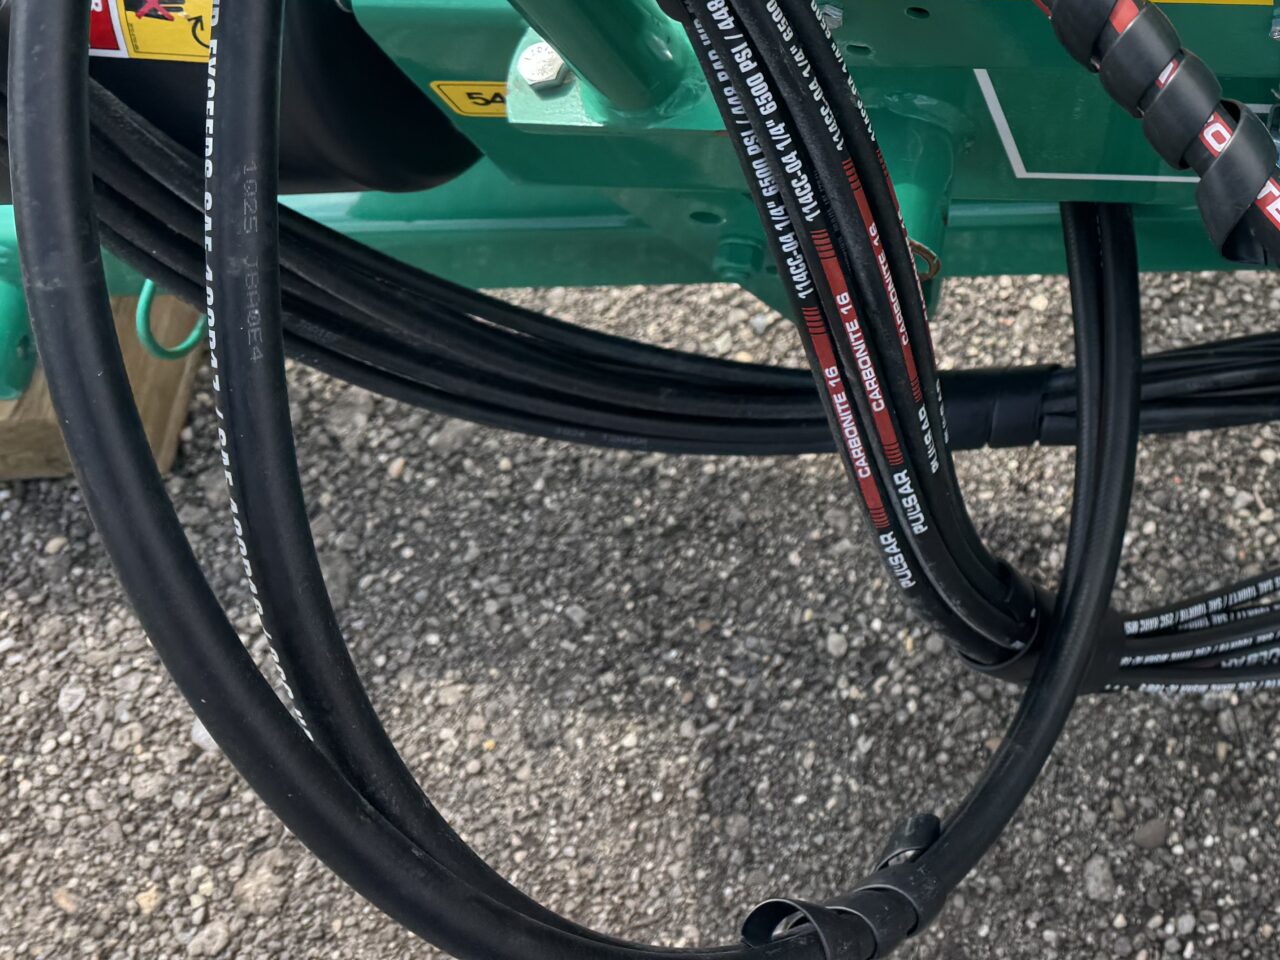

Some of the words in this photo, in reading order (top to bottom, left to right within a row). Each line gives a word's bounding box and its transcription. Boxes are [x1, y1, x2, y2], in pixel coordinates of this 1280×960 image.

[730, 42, 758, 73] PSI
[745, 71, 778, 117] 6500
[765, 118, 793, 152] 1/4"
[780, 149, 821, 223] 114CC-04
[789, 44, 812, 79] 1/4"
[807, 76, 845, 152] 114CC-04
[740, 130, 762, 157] PSI
[751, 157, 778, 198] 6500
[765, 200, 791, 232] 1/4"
[778, 231, 815, 300] 114CC-04
[824, 365, 842, 388] 16
[835, 291, 853, 315] 16
[844, 318, 886, 413] CARBONITE
[832, 391, 873, 480] CARBONITE
[892, 468, 929, 536] PULSAR
[878, 530, 917, 590] PULSAR
